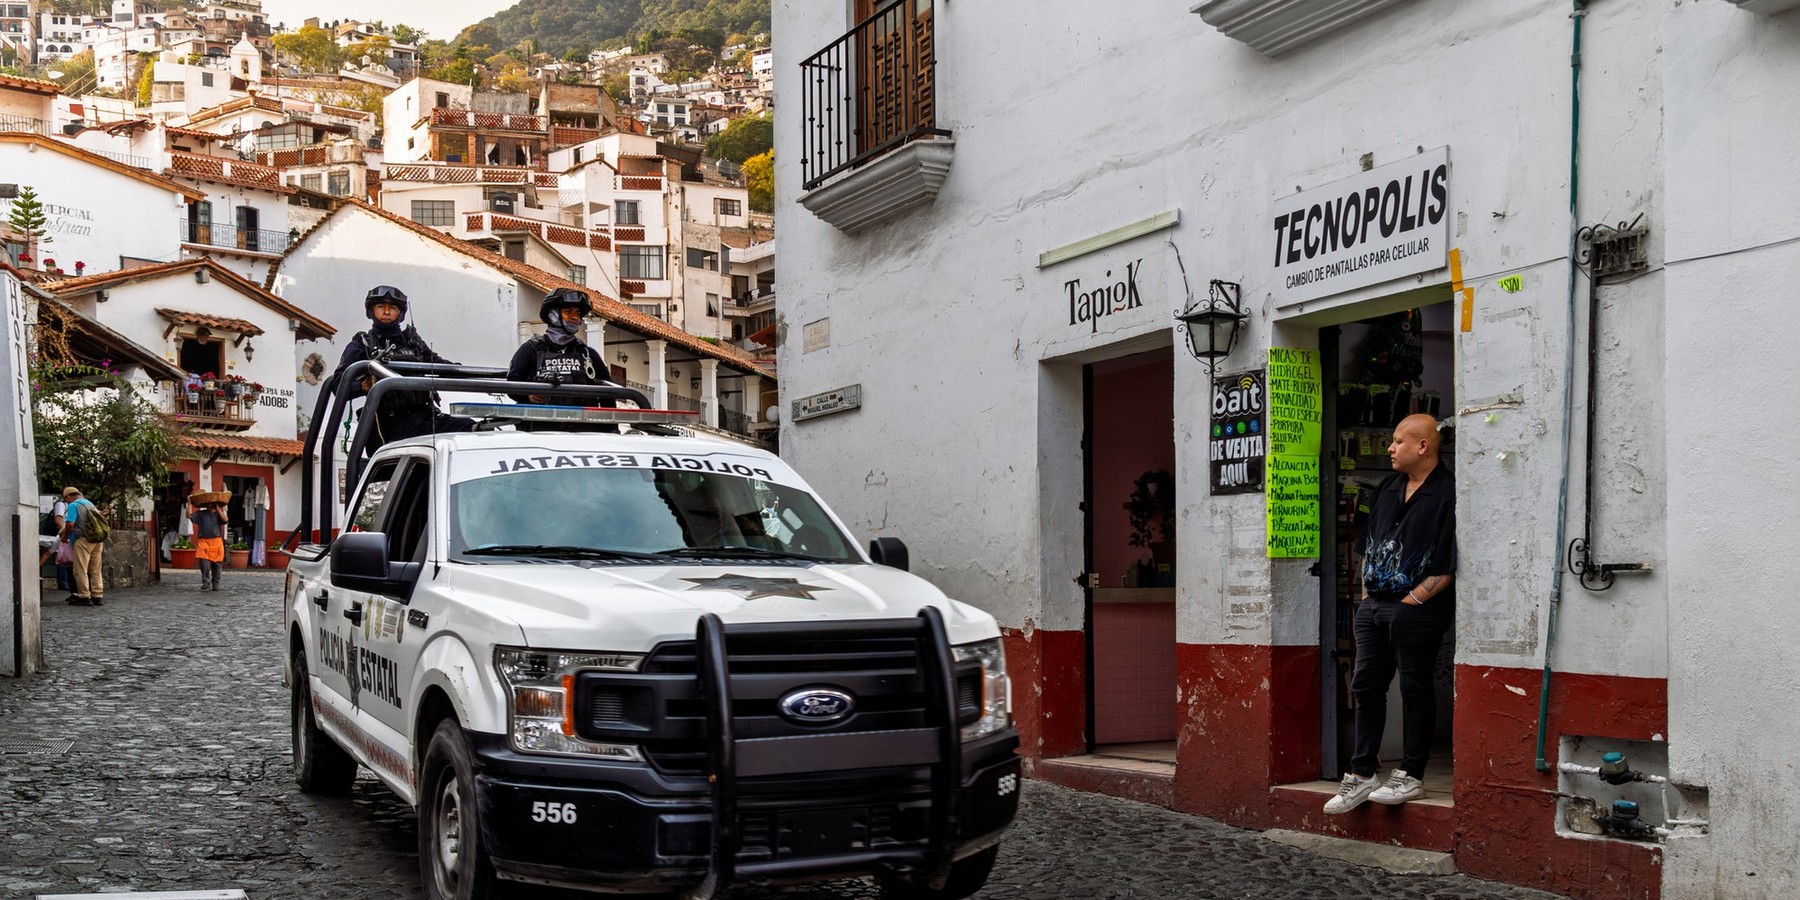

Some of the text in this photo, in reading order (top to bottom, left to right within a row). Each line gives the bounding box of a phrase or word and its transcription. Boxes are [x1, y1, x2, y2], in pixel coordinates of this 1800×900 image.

[1274, 164, 1447, 267] TECNOPOLIS
[1286, 237, 1430, 289] CAMBIO DE PANTALLAS PARA CELULAR
[8, 279, 29, 449] HOTEL
[1269, 348, 1313, 365] MICAS DE
[1269, 364, 1315, 380] HIDROGEL
[259, 396, 289, 409] ADOBE
[816, 396, 829, 404] CALLE
[822, 401, 839, 410] HIDALGO
[1212, 382, 1261, 415] bait
[1210, 435, 1264, 461] DE VENTA
[1220, 459, 1249, 487] AQUÍ
[360, 646, 402, 710] ESTATAL
[800, 697, 840, 715] Ford
[998, 773, 1017, 796] 556
[531, 801, 577, 825] 556
